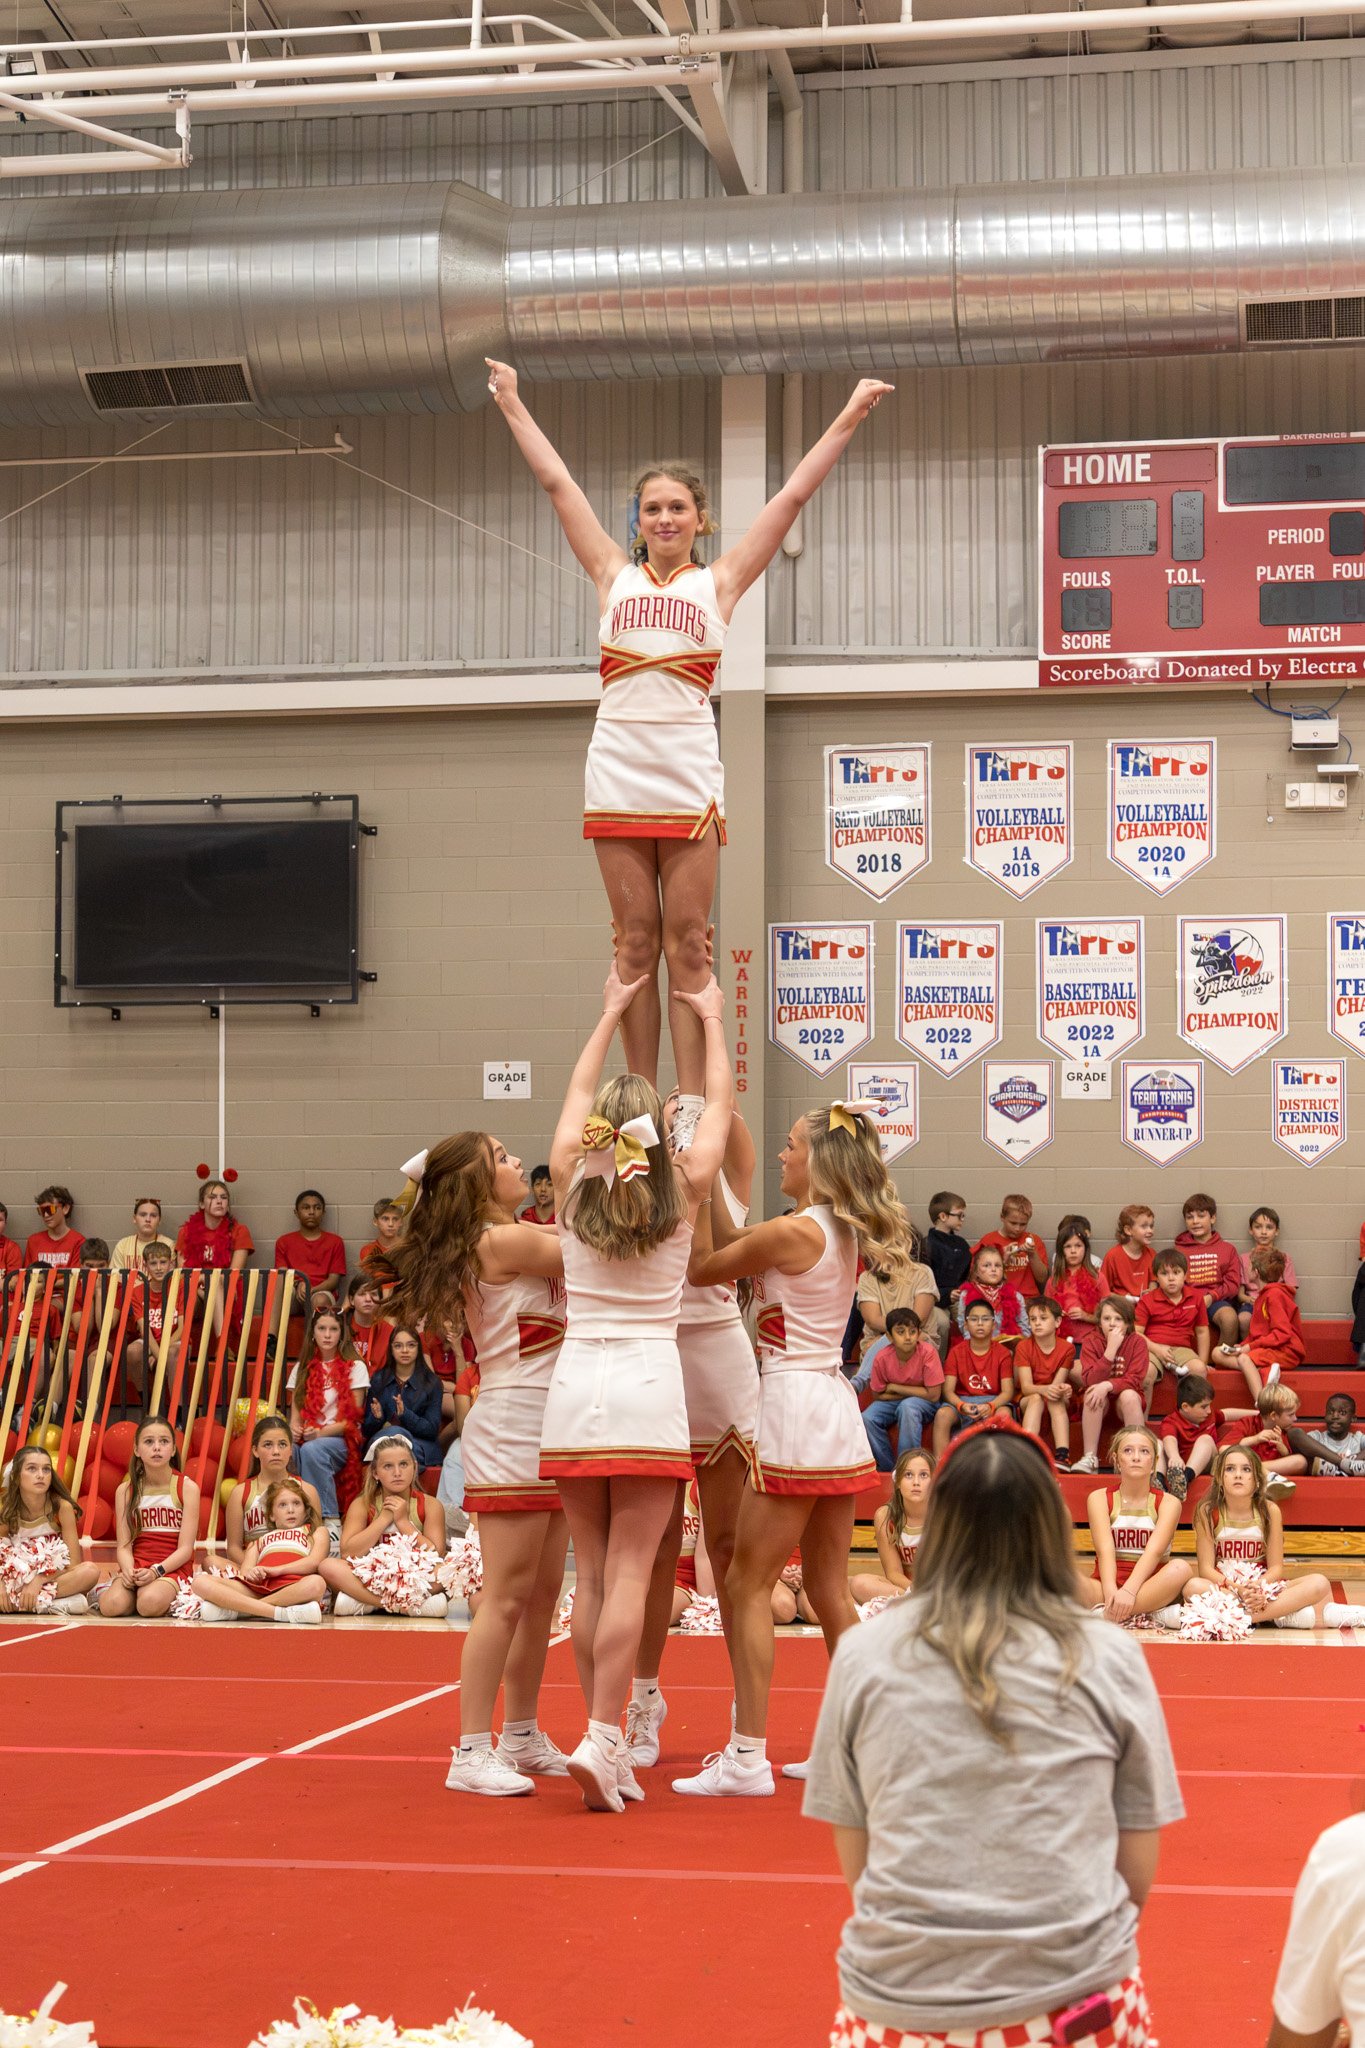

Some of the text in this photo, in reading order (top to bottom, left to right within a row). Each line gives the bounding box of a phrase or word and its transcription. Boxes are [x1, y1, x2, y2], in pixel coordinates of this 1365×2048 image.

[1283, 432, 1348, 440] DAKTRONICS
[1063, 453, 1151, 484] HOME
[1268, 527, 1325, 544] PERIOD
[1062, 571, 1111, 587] FOULS
[1165, 569, 1205, 584] T.O.L.
[1256, 564, 1315, 581] PLAYER
[1333, 563, 1365, 579] FOU
[611, 595, 707, 644] WARRIORS
[1061, 634, 1111, 650] SCORE
[1288, 626, 1341, 643] MATCH
[1050, 662, 1160, 682] Scoreboard
[1167, 660, 1252, 678] Donated
[1258, 660, 1282, 679] by
[1288, 658, 1358, 675] Electra
[864, 808, 924, 828] VOLLEYBALL
[976, 807, 1065, 827] VOLLEYBALL
[1116, 803, 1208, 823] VOLLEYBALL
[835, 827, 924, 848] CHAMPIONS
[975, 826, 1066, 847] CHAMPION
[1116, 822, 1208, 842] CHAMPION
[1012, 846, 1032, 860] 1A
[1138, 846, 1186, 862] 2020
[857, 853, 902, 873] 2018
[1002, 862, 1040, 877] 2018
[904, 985, 994, 1004] BASKETBALL
[1045, 982, 1136, 1001] BASKETBALL
[1193, 966, 1275, 1006] Spikedown
[1240, 987, 1264, 997] 2022
[777, 986, 865, 1005] VOLLEYBALL
[777, 1004, 865, 1025] CHAMPION
[904, 1004, 994, 1024] CHAMPIONS
[1045, 1000, 1136, 1021] CHAMPIONS
[731, 949, 753, 1092] WARRIORS
[1186, 1012, 1279, 1033] CHAMPION
[799, 1028, 845, 1044] 2022
[925, 1027, 972, 1044] 2022
[1067, 1024, 1114, 1041] 2022
[813, 1048, 832, 1061] 1A
[940, 1047, 958, 1060] 1A
[1082, 1045, 1102, 1058] 1A
[488, 1073, 526, 1082] GRADE
[1066, 1072, 1107, 1082] GRADE
[503, 1083, 511, 1092] 4
[1007, 1084, 1029, 1092] STATE
[1082, 1083, 1090, 1092] 3
[990, 1091, 1046, 1104] CHAMPIONSHIP
[1132, 1090, 1193, 1106] TEAM TENNIS
[1279, 1099, 1339, 1110] DISTRICT
[1279, 1111, 1339, 1123] TENNIS
[876, 1124, 914, 1137] MPION
[1133, 1127, 1192, 1141] RUNNER-UP
[1279, 1124, 1339, 1137] CHAMPION
[132, 1507, 183, 1528] RRIORS
[259, 1530, 308, 1551] RRIORS
[1111, 1528, 1153, 1549] RRIO
[1216, 1540, 1264, 1559] ARRIOR
